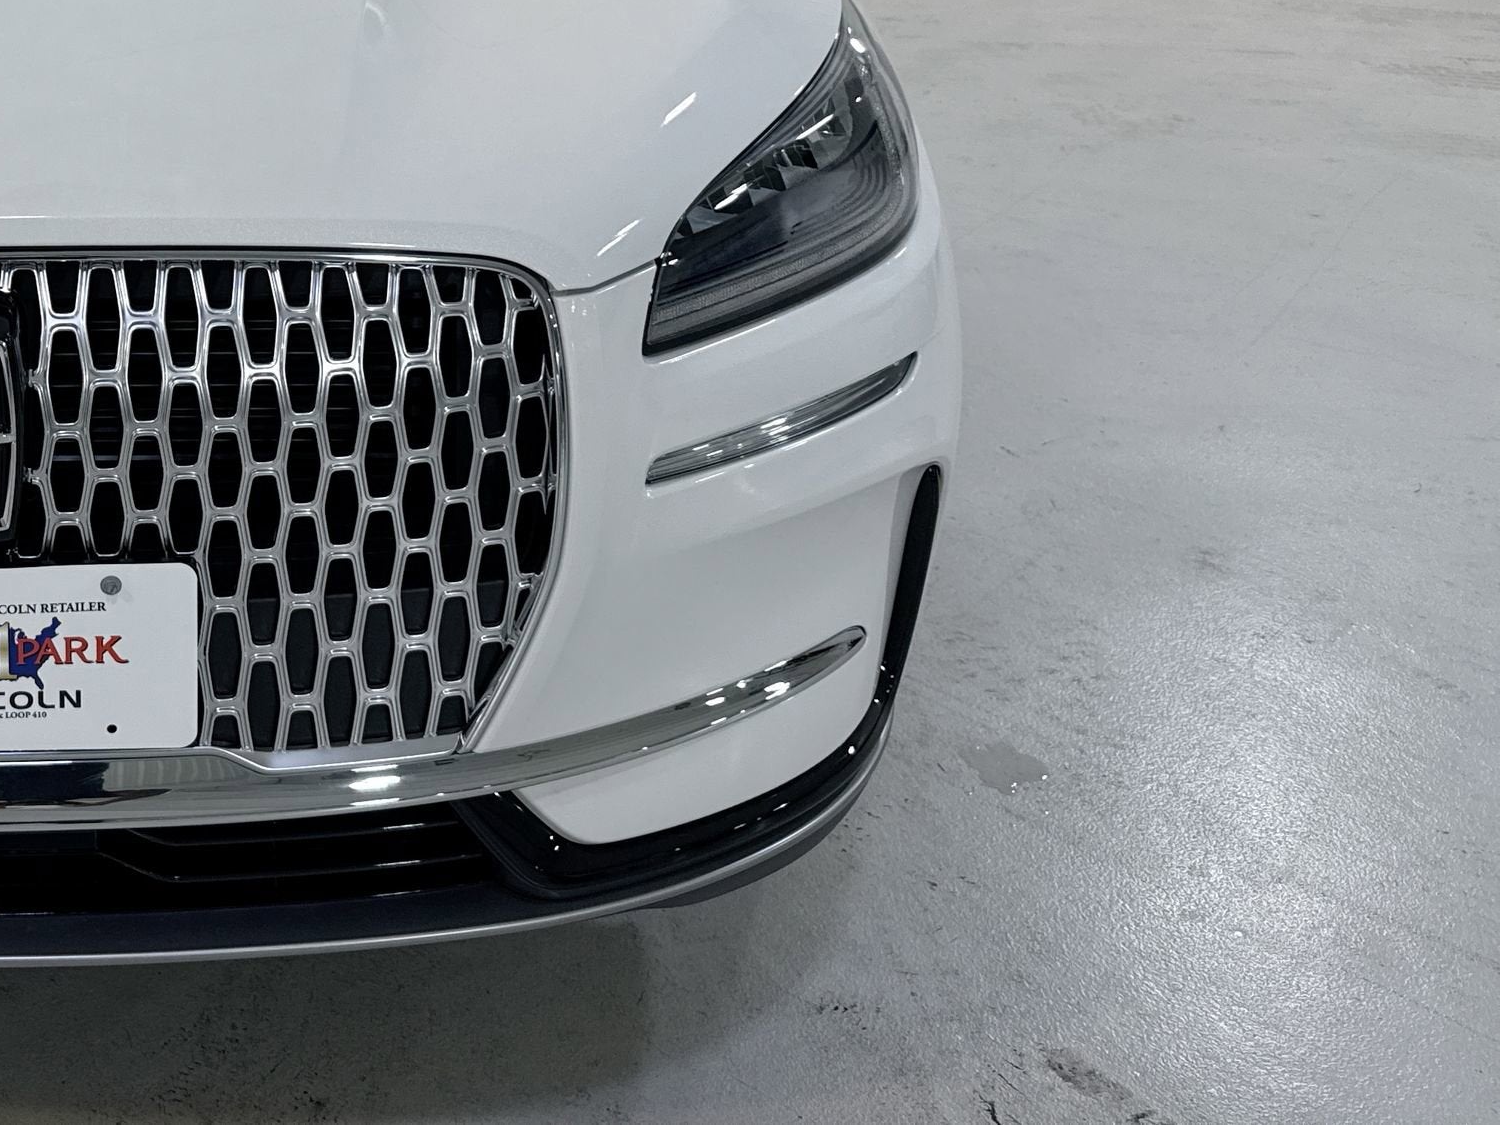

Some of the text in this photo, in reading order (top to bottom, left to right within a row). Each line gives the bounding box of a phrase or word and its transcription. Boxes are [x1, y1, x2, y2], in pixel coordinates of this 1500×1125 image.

[41, 601, 107, 613] RETAILER
[15, 634, 129, 666] PARK
[5, 711, 31, 719] LOOP
